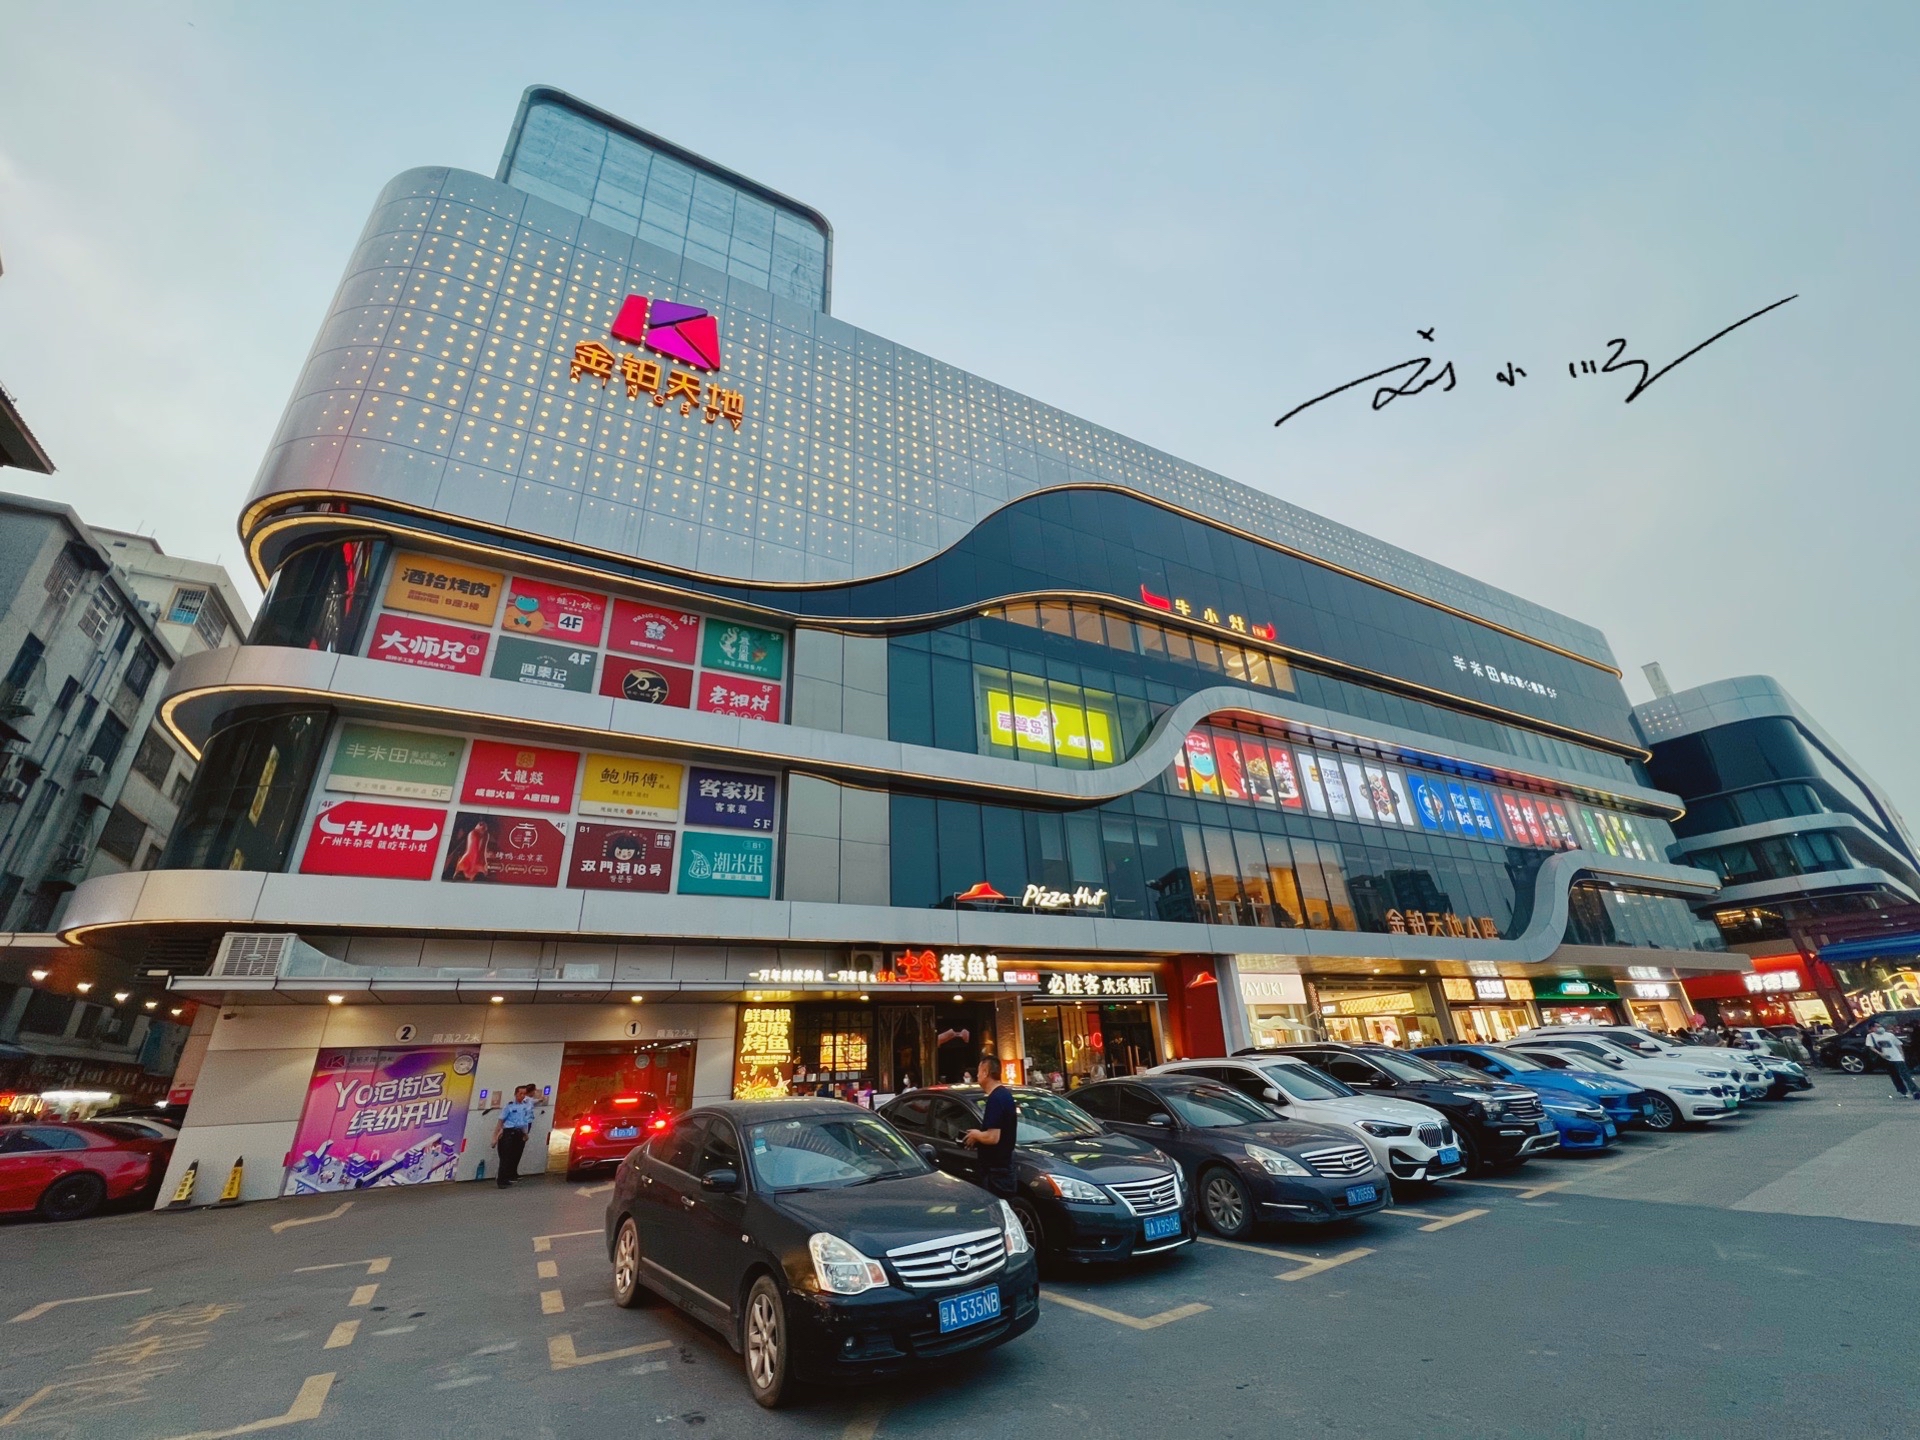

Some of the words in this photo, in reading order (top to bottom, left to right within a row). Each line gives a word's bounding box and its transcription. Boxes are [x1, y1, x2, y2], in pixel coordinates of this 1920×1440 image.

[570, 341, 744, 419] 金铂天地
[560, 616, 581, 629] 4F
[679, 615, 698, 626] 4F
[378, 630, 466, 663] 大师兄
[568, 652, 591, 666] 4F
[709, 685, 769, 712] 老湘村
[762, 685, 773, 693] 5F
[346, 743, 408, 763] 半米田
[600, 768, 658, 789] 鲍师傅
[431, 788, 447, 798] 5F
[700, 779, 765, 802] 客家班
[346, 820, 410, 840] 牛小灶
[713, 852, 763, 874] 潮米果
[1023, 884, 1071, 907] Pizza
[1073, 886, 1107, 906] Hut
[1047, 973, 1100, 995] 必胜客
[1102, 977, 1152, 995] 欢乐餐厅
[401, 1026, 411, 1040] 2
[432, 1033, 480, 1043] 限高2.2米
[631, 1023, 637, 1035] 1
[656, 1029, 695, 1038] 限高2.2米
[745, 1022, 788, 1036] 爽麻
[741, 1035, 791, 1053] 烤鱼
[346, 1098, 452, 1136] 缤纷开业
